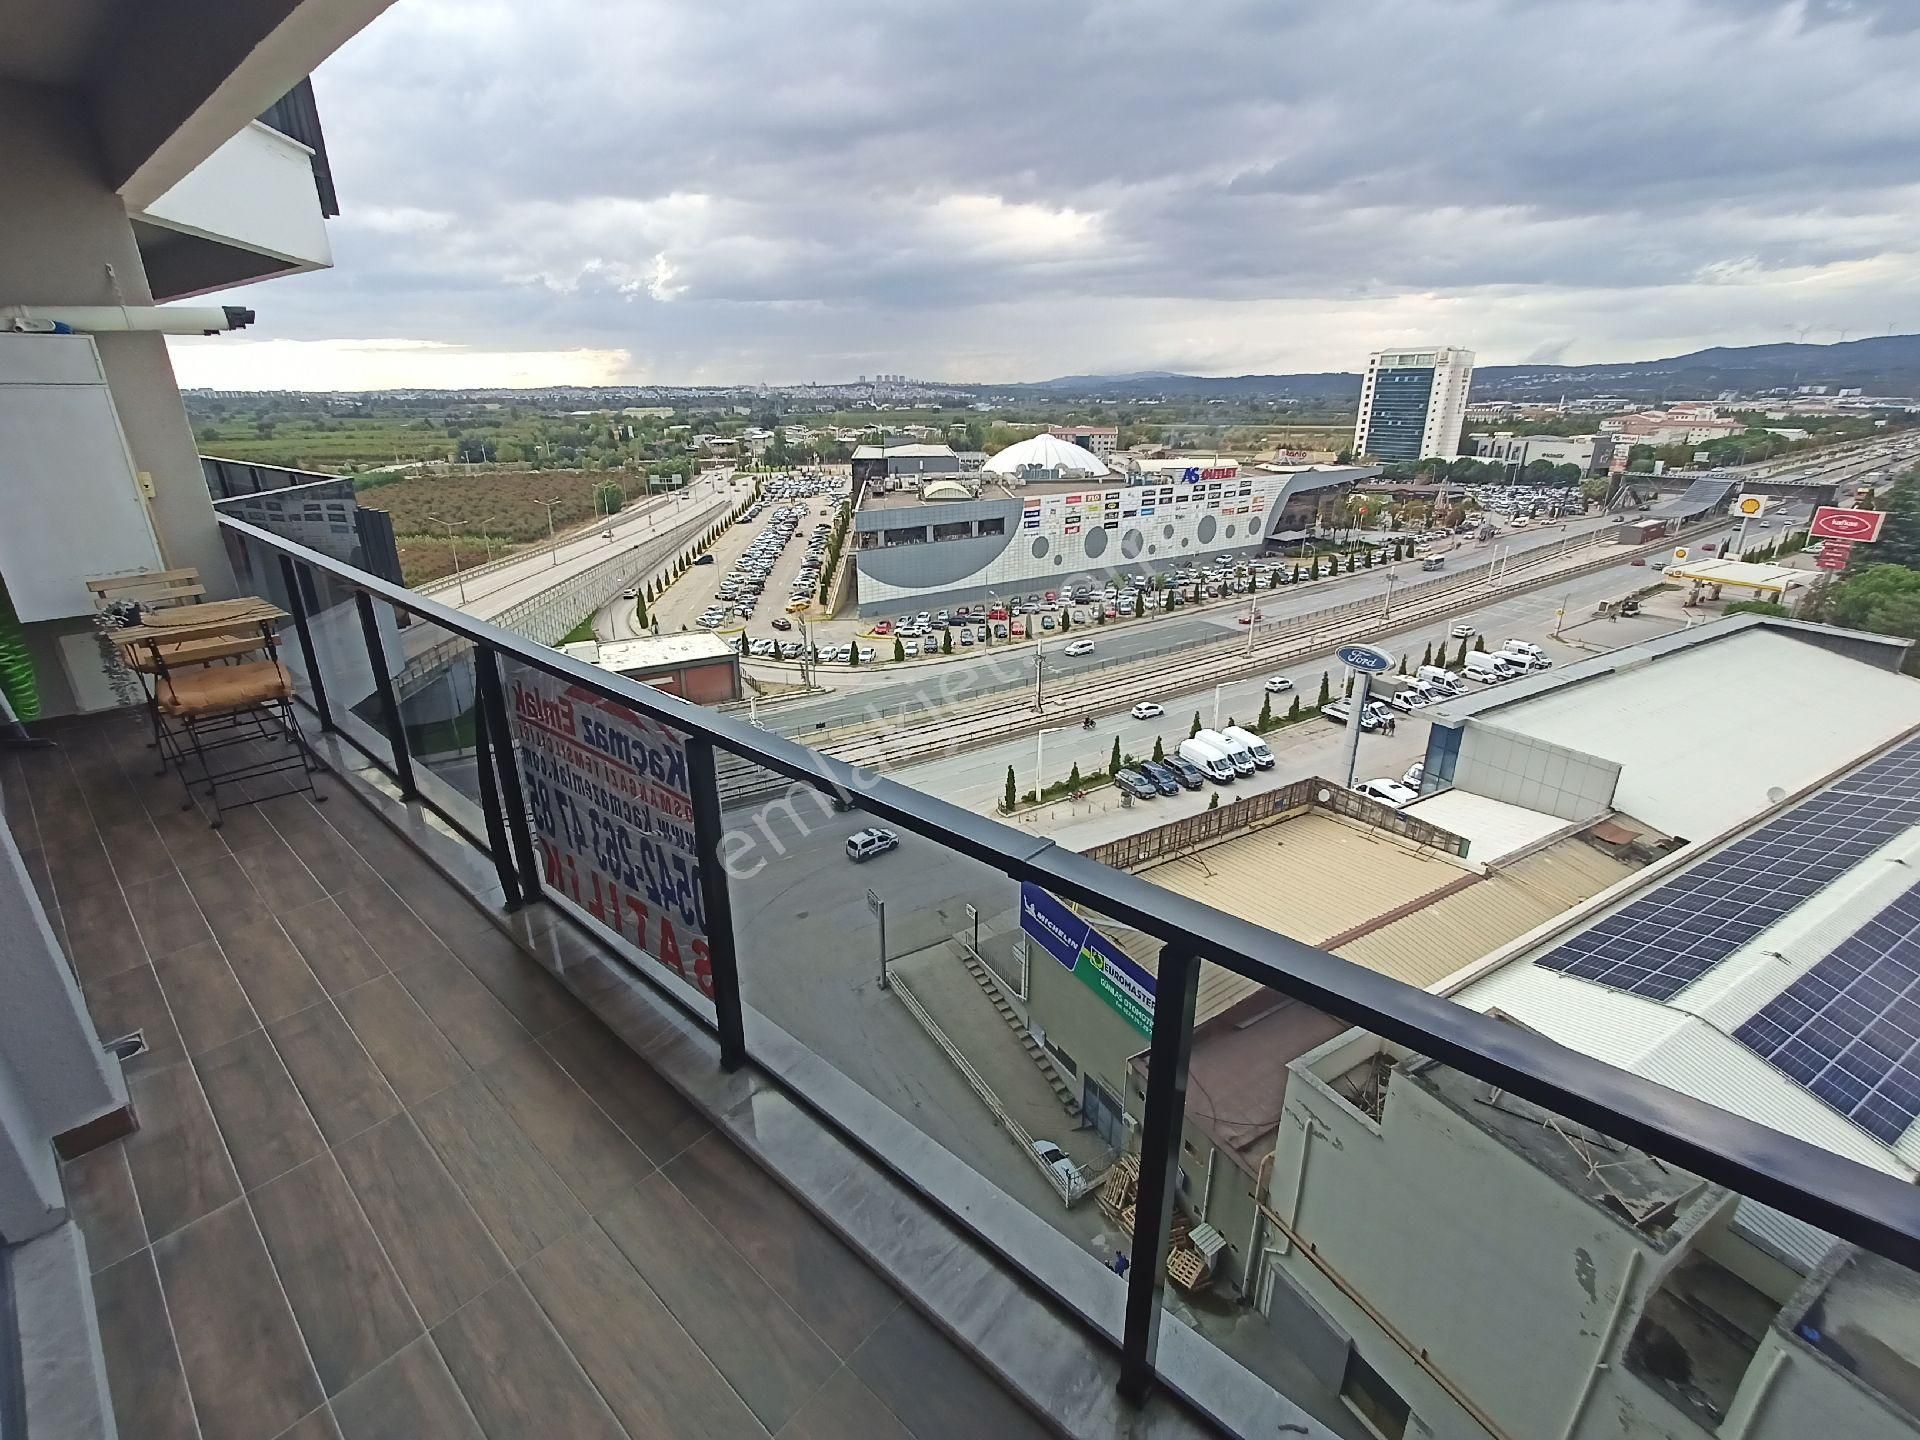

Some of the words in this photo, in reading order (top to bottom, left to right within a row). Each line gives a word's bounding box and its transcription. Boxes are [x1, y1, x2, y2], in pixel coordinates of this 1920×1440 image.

[1181, 467, 1200, 484] AS
[1201, 467, 1238, 480] OUTLET
[1347, 650, 1377, 667] Ford
[1036, 913, 1078, 949] MICHELIN
